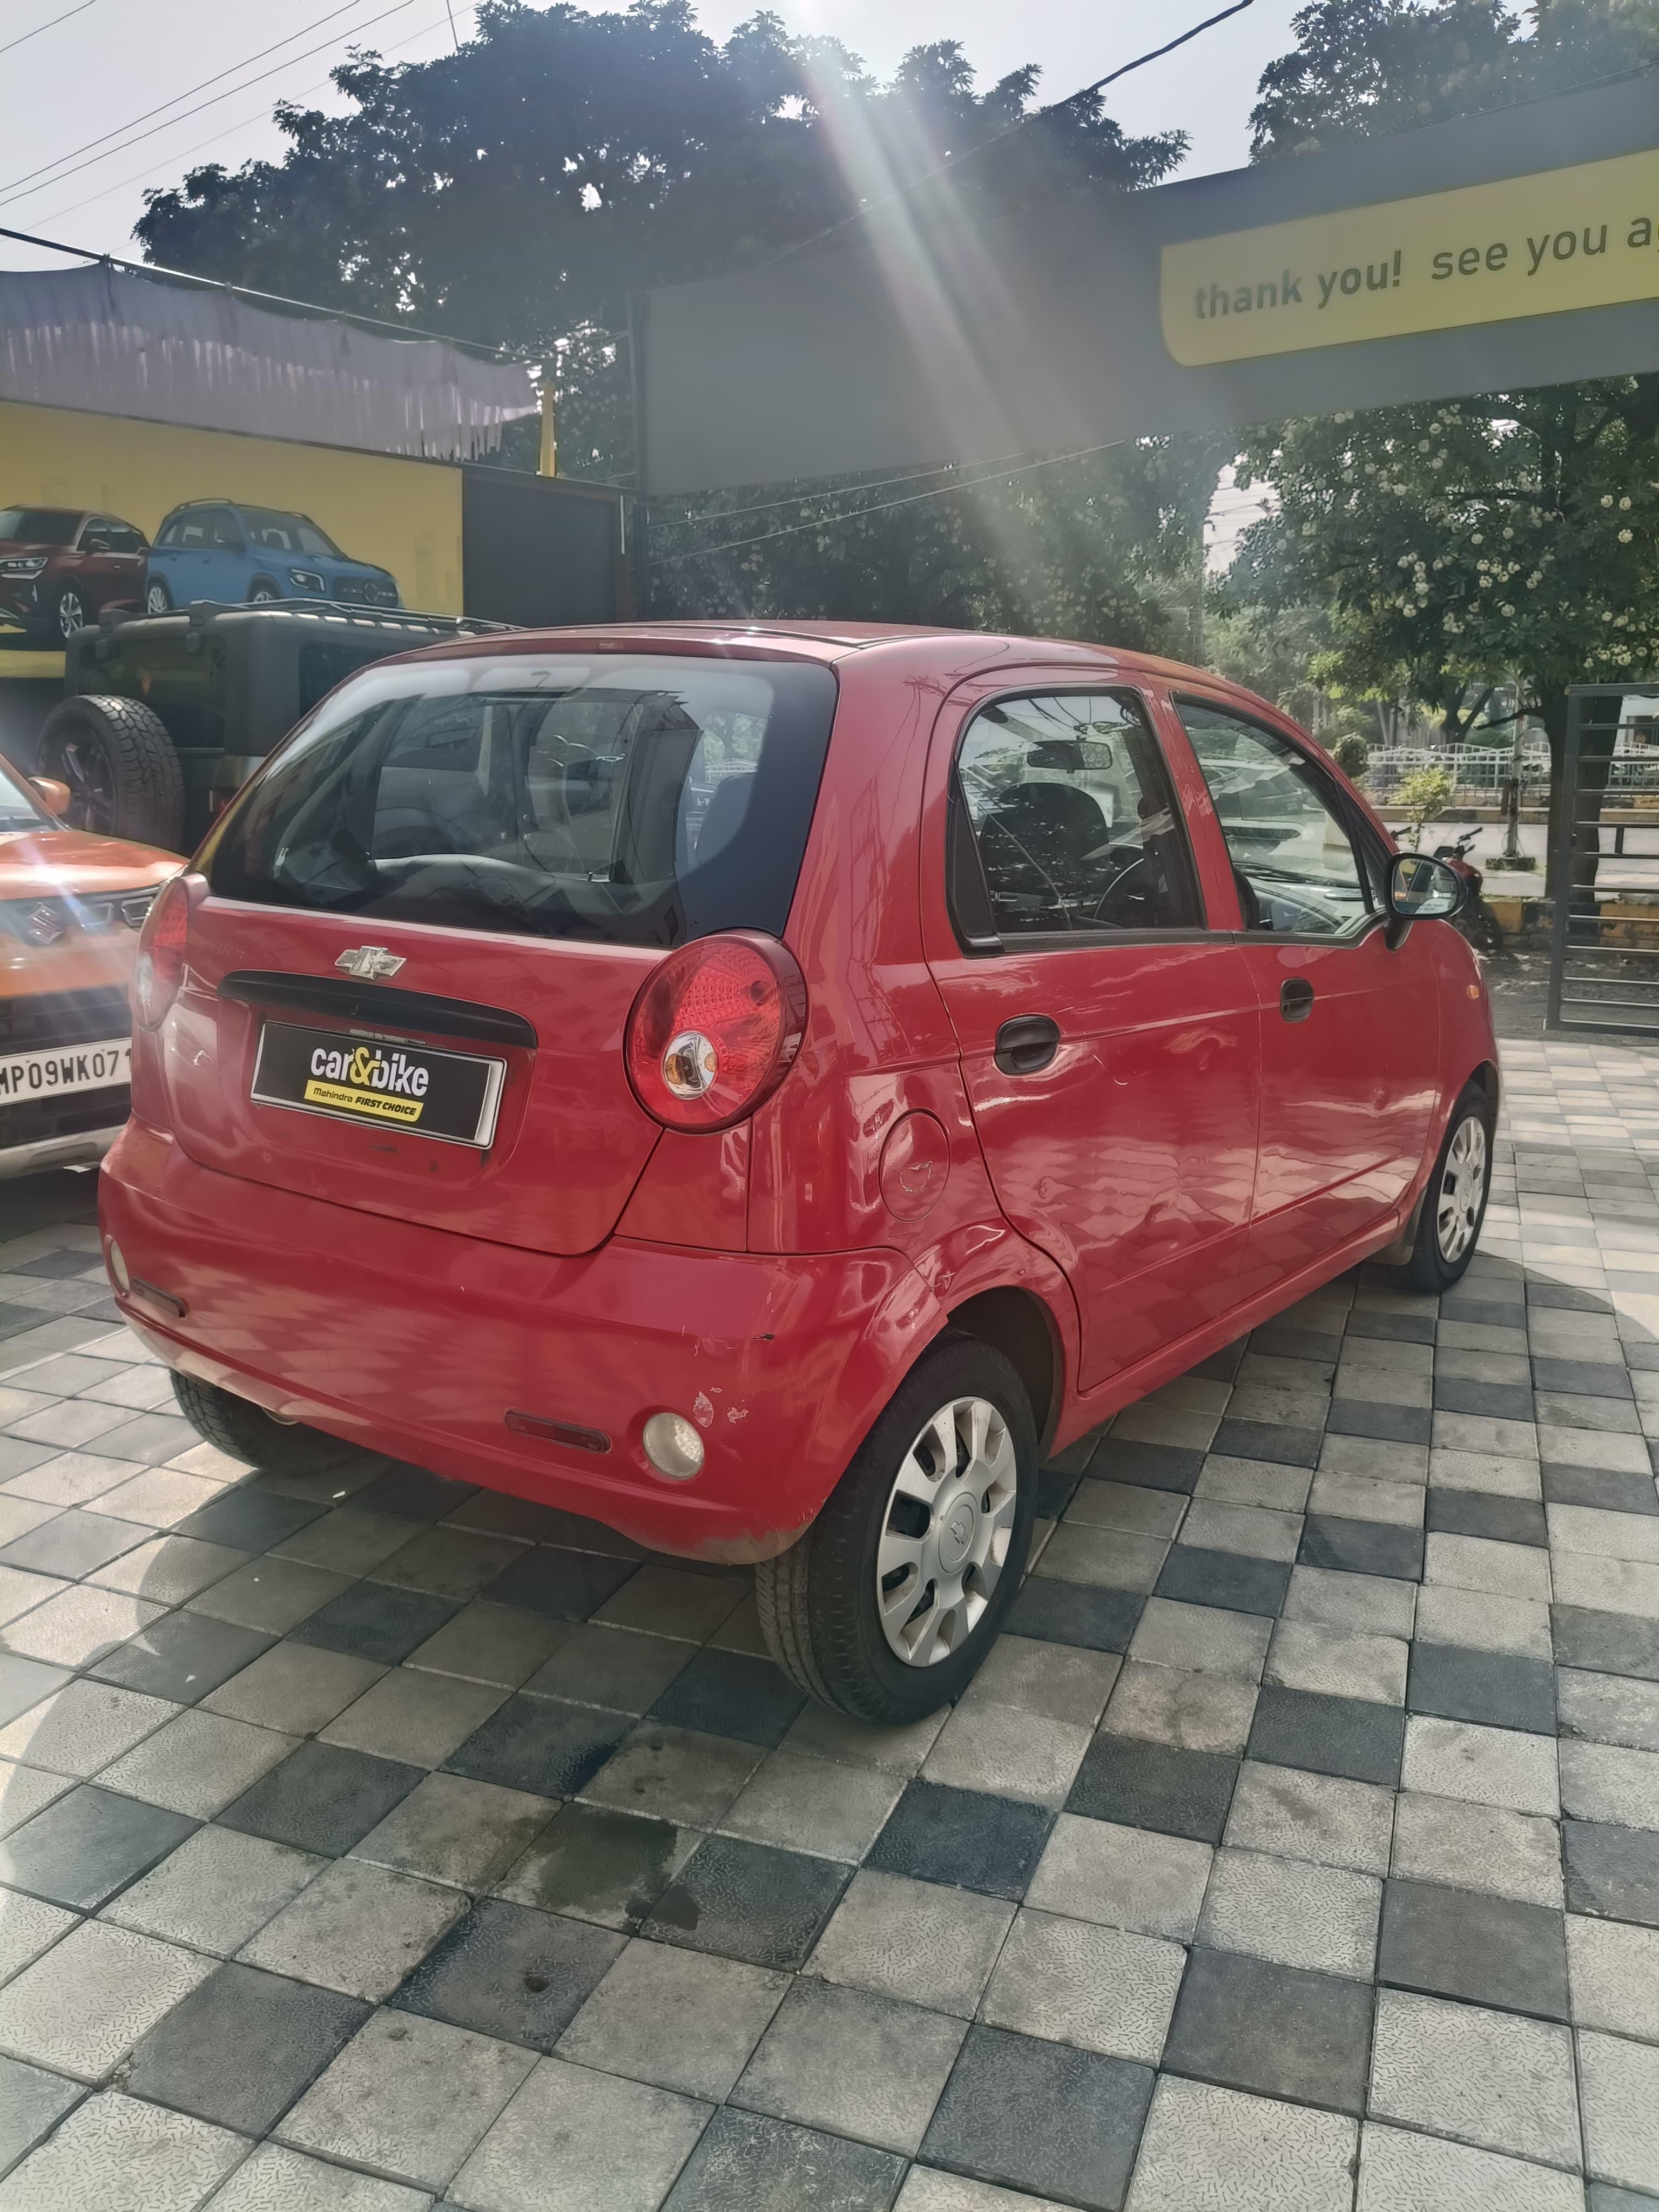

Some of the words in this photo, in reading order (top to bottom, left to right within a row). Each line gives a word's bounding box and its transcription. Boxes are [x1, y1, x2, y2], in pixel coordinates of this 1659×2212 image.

[1195, 269, 1303, 319] thank
[1318, 250, 1401, 309] you!
[1431, 242, 1508, 280] see
[1527, 224, 1608, 276] you
[1628, 217, 1659, 253] a
[311, 1046, 429, 1097] car&bike
[313, 1087, 353, 1102] Mahindra
[355, 1096, 382, 1108] FIRST
[382, 1102, 417, 1116] CHOICE
